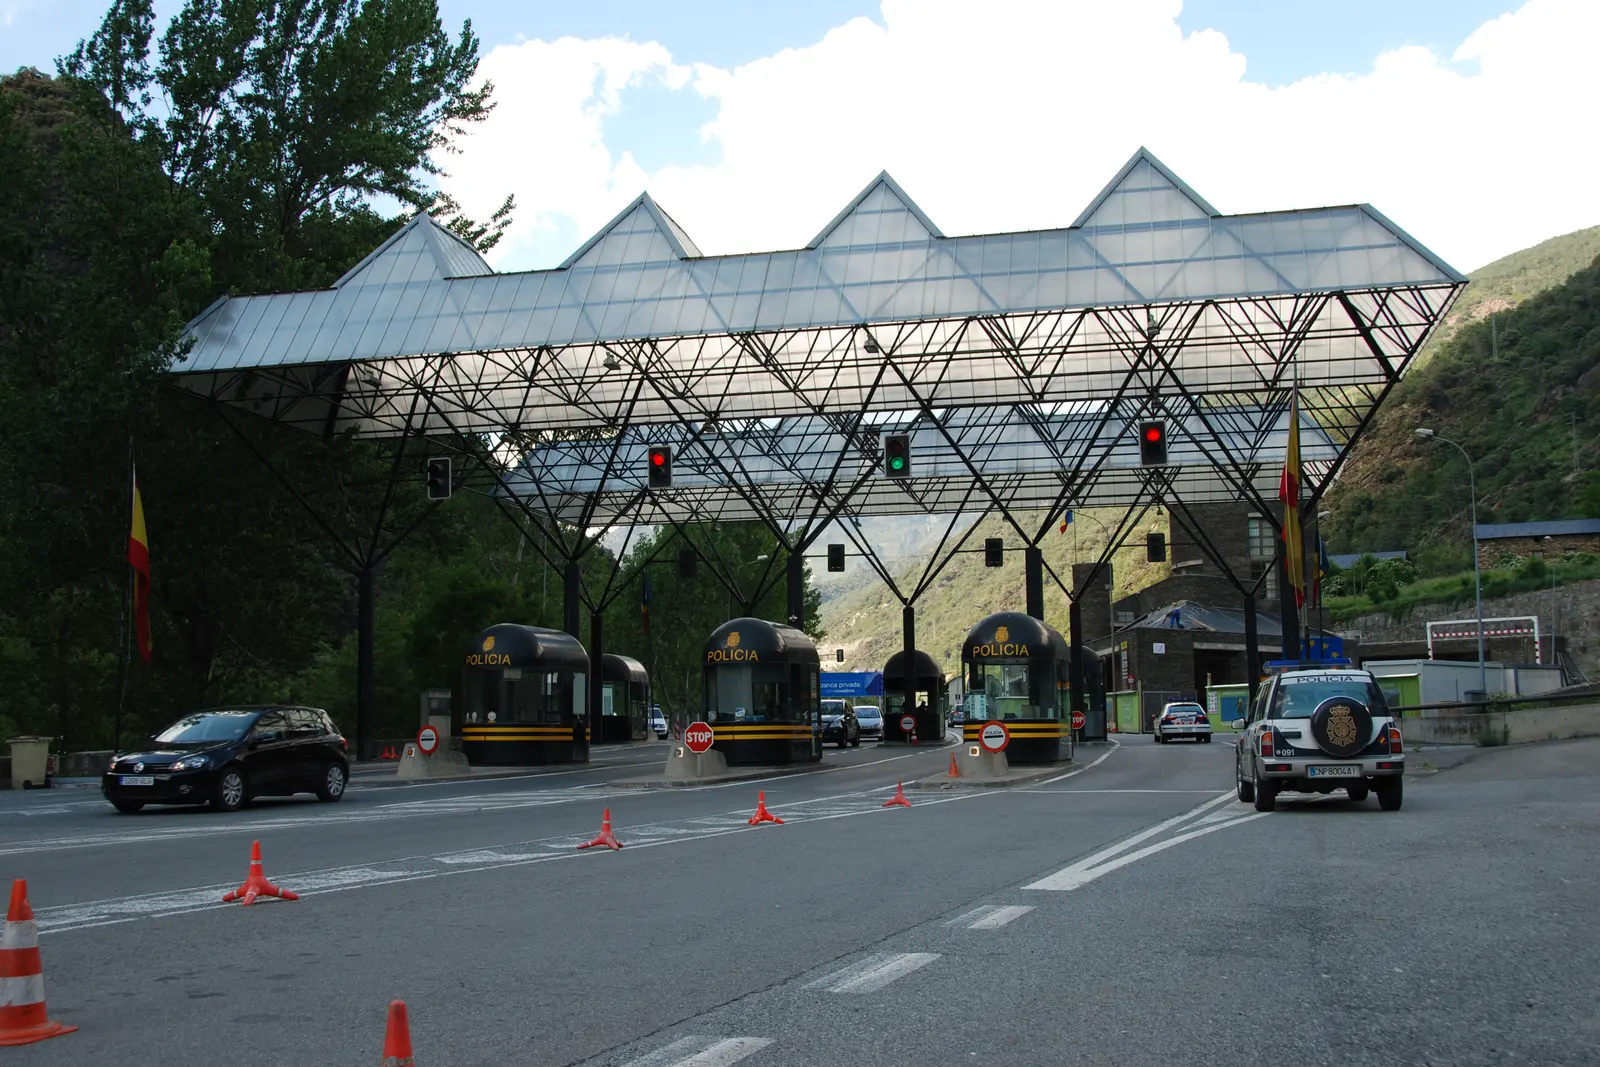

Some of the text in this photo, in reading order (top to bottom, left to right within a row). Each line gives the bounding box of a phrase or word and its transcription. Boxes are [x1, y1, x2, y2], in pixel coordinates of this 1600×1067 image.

[707, 649, 759, 662] POLICIA
[973, 643, 1030, 658] POLICIA
[465, 653, 511, 666] POLICIA
[838, 681, 861, 689] privada
[1297, 675, 1354, 684] POLICIA
[1072, 716, 1084, 724] TOP
[686, 731, 712, 743] STOP
